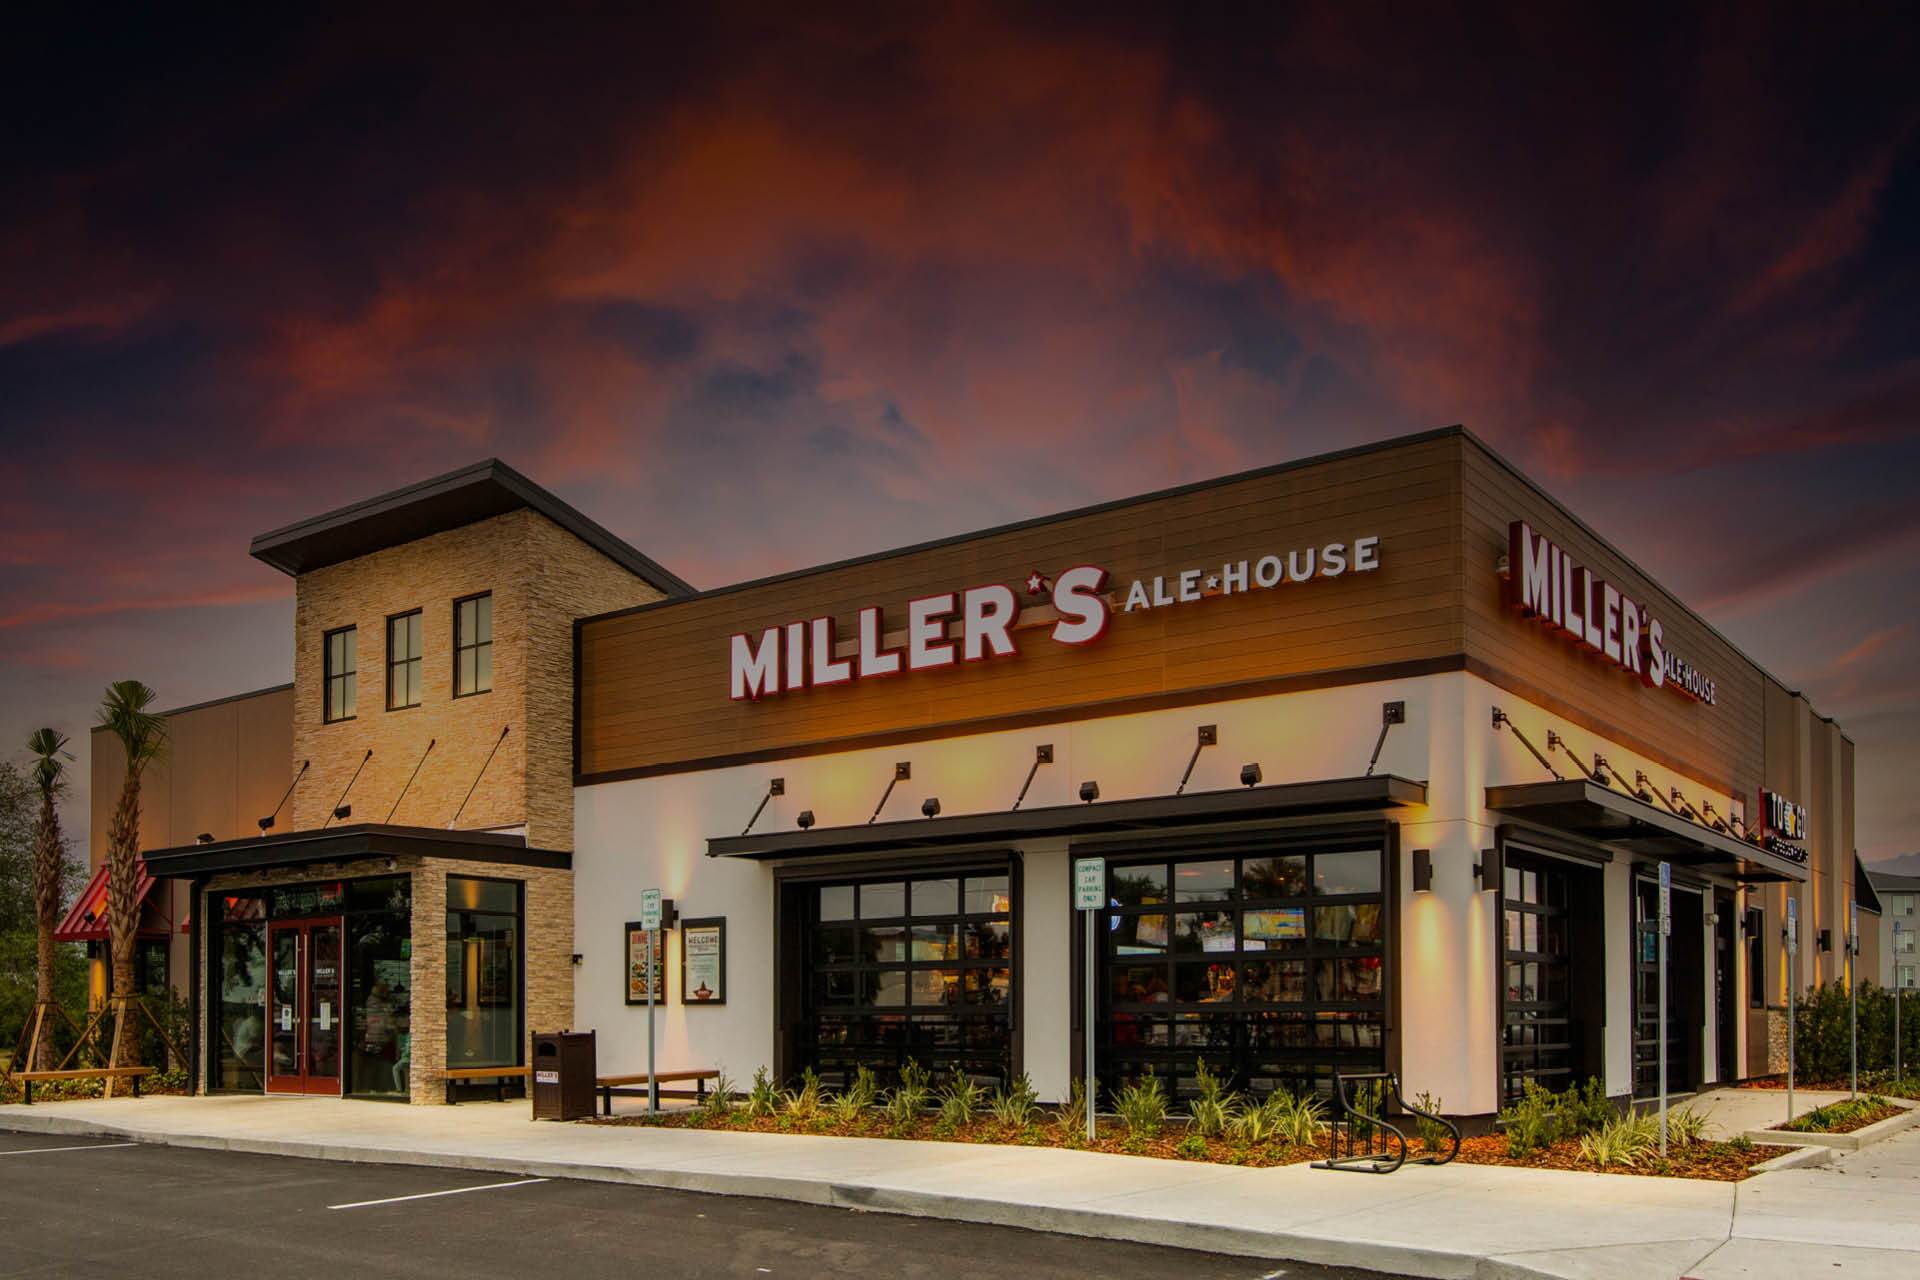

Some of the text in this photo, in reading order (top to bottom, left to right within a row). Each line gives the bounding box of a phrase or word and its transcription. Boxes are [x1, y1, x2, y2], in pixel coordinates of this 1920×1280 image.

[729, 536, 1380, 701] MILLER'S ALE HOUSE
[1517, 522, 1716, 706] MILLER'S ALE HOUSE
[1771, 791, 1784, 831] TO
[1078, 864, 1102, 873] COMPACT
[687, 935, 719, 945] WELCOME
